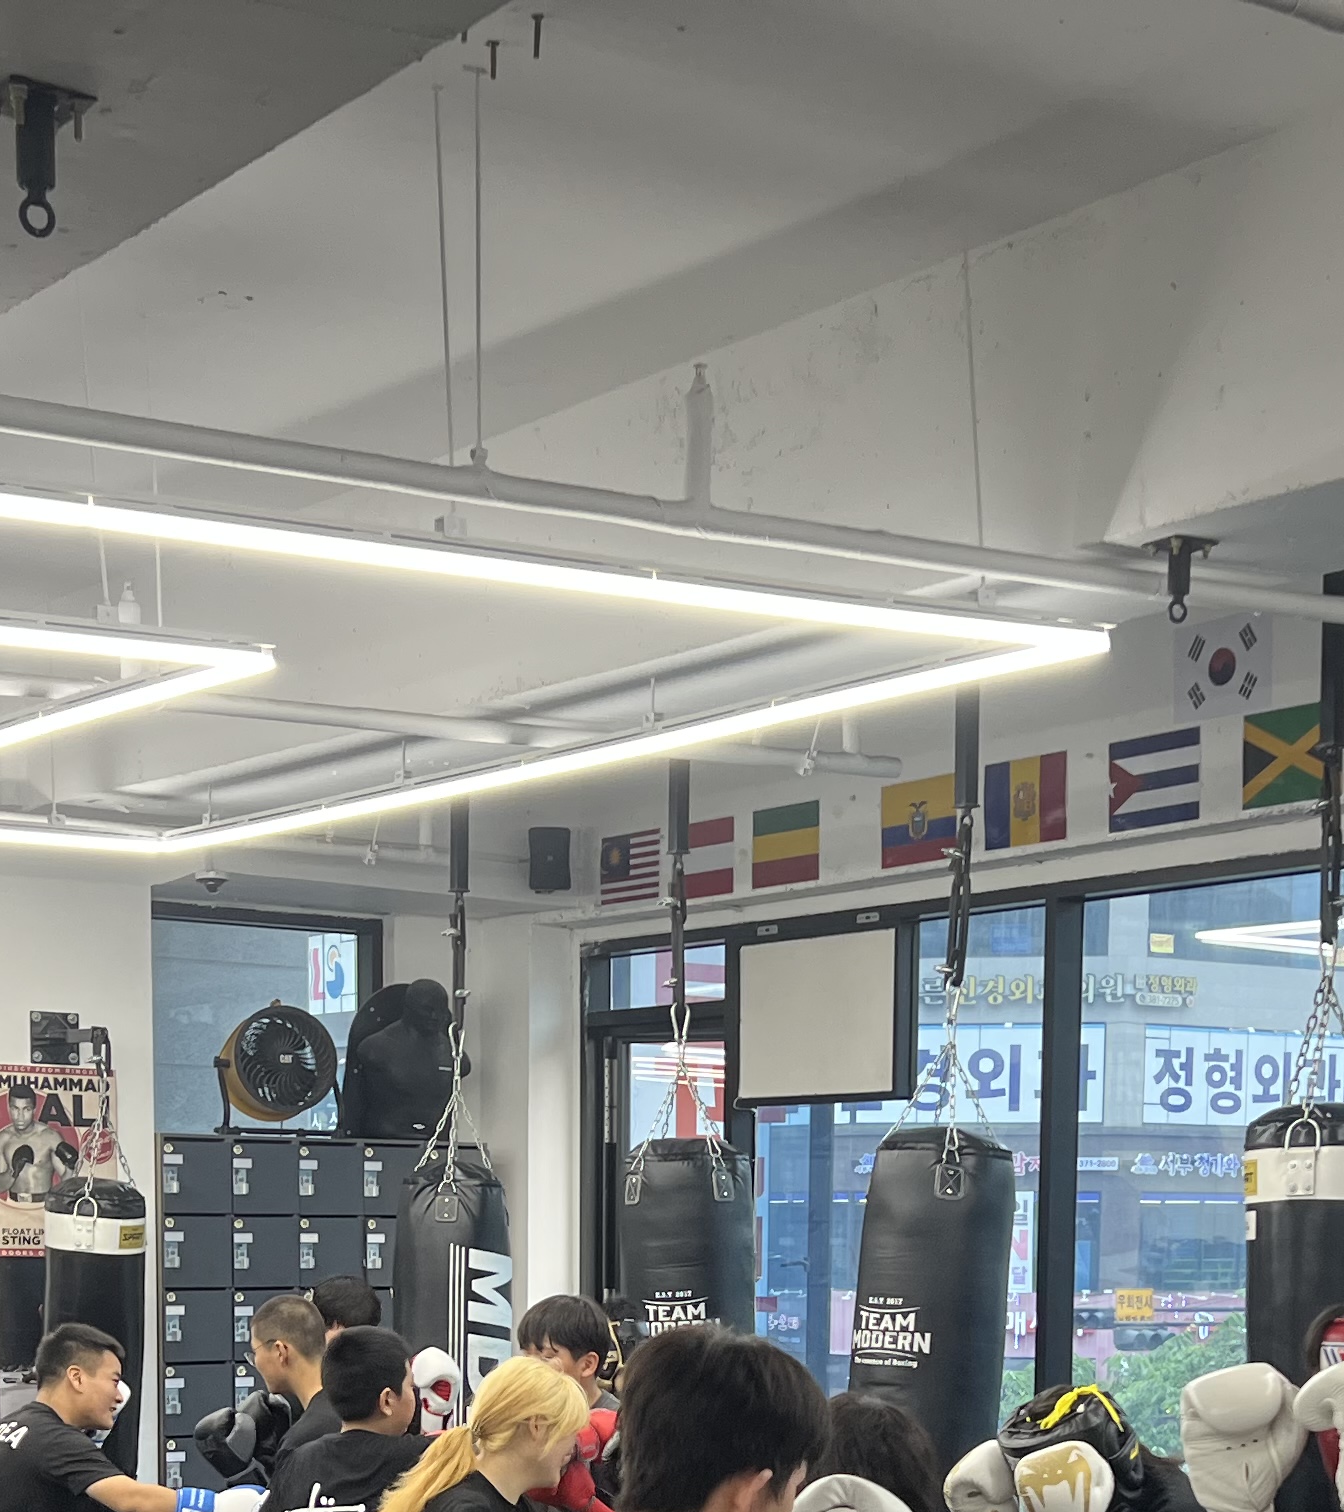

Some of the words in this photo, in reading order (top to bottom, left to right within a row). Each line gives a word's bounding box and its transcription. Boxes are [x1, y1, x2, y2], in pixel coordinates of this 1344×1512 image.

[1153, 1046, 1343, 1115] 정형외과
[1, 1228, 31, 1236] FLOAT
[1, 1235, 41, 1246] STING
[644, 1302, 706, 1321] TEAM
[859, 1310, 916, 1332] TEAM
[852, 1329, 932, 1354] MODERN
